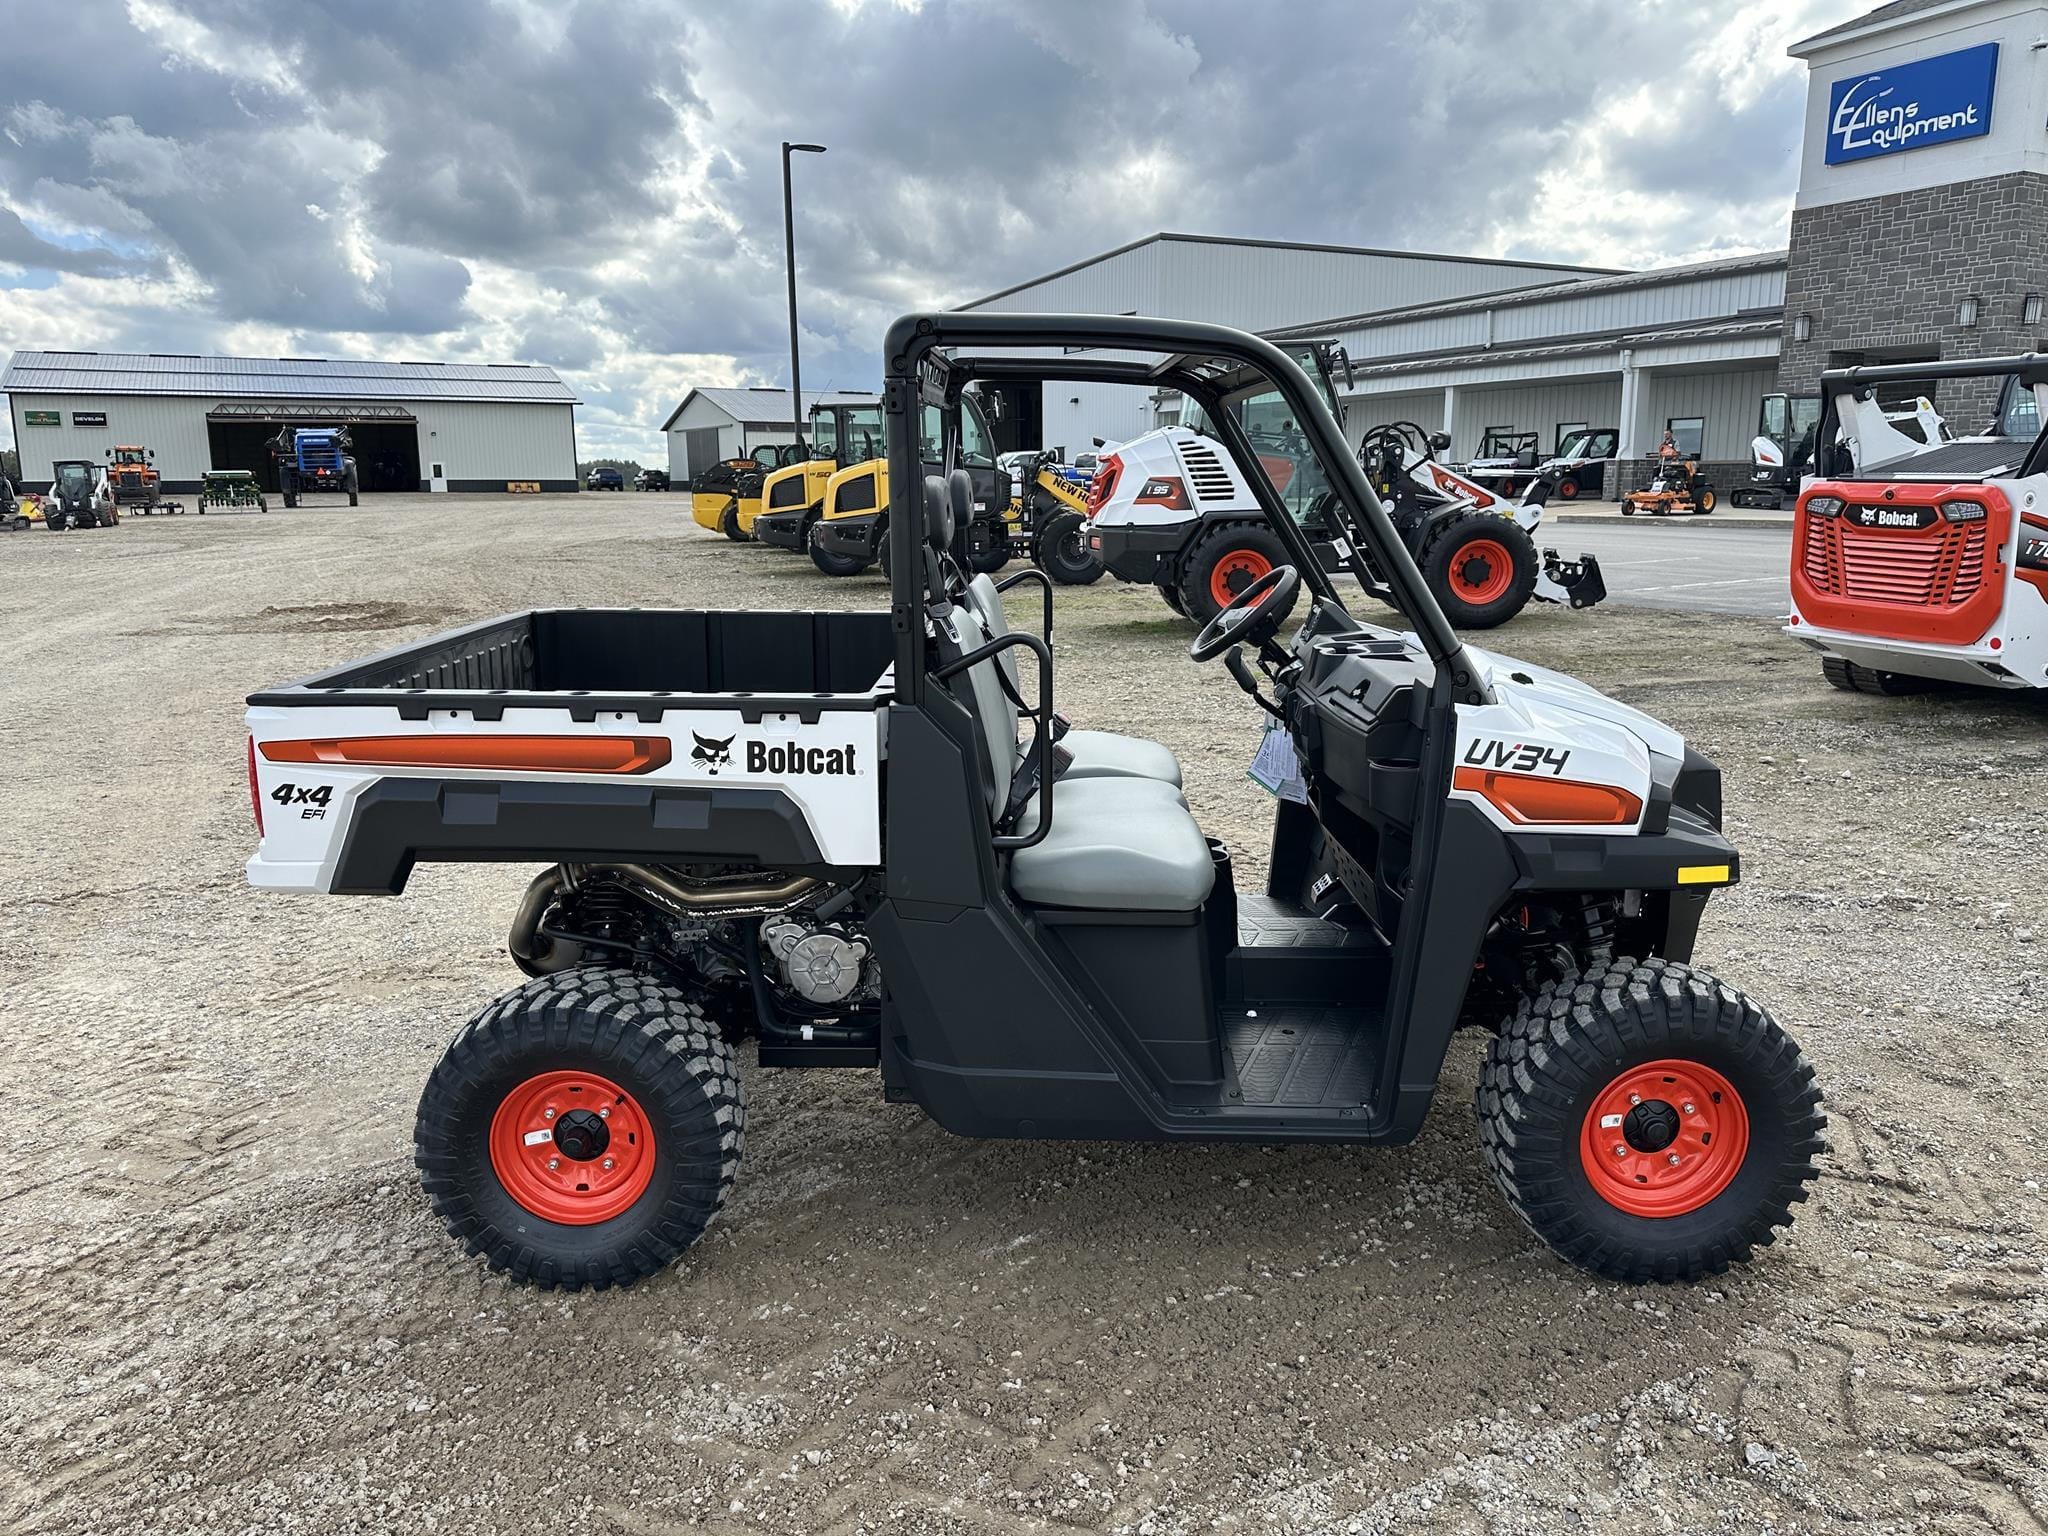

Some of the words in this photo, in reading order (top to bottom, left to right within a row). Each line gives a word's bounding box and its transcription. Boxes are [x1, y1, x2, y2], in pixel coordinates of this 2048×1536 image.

[1843, 88, 1977, 149] Equipment
[1053, 477, 1077, 497] NEW
[1878, 511, 1918, 526] Bobcat
[747, 741, 856, 775] Bobcat
[1464, 738, 1571, 775] UV34
[271, 783, 334, 808] 4x4
[301, 808, 327, 820] EFI
